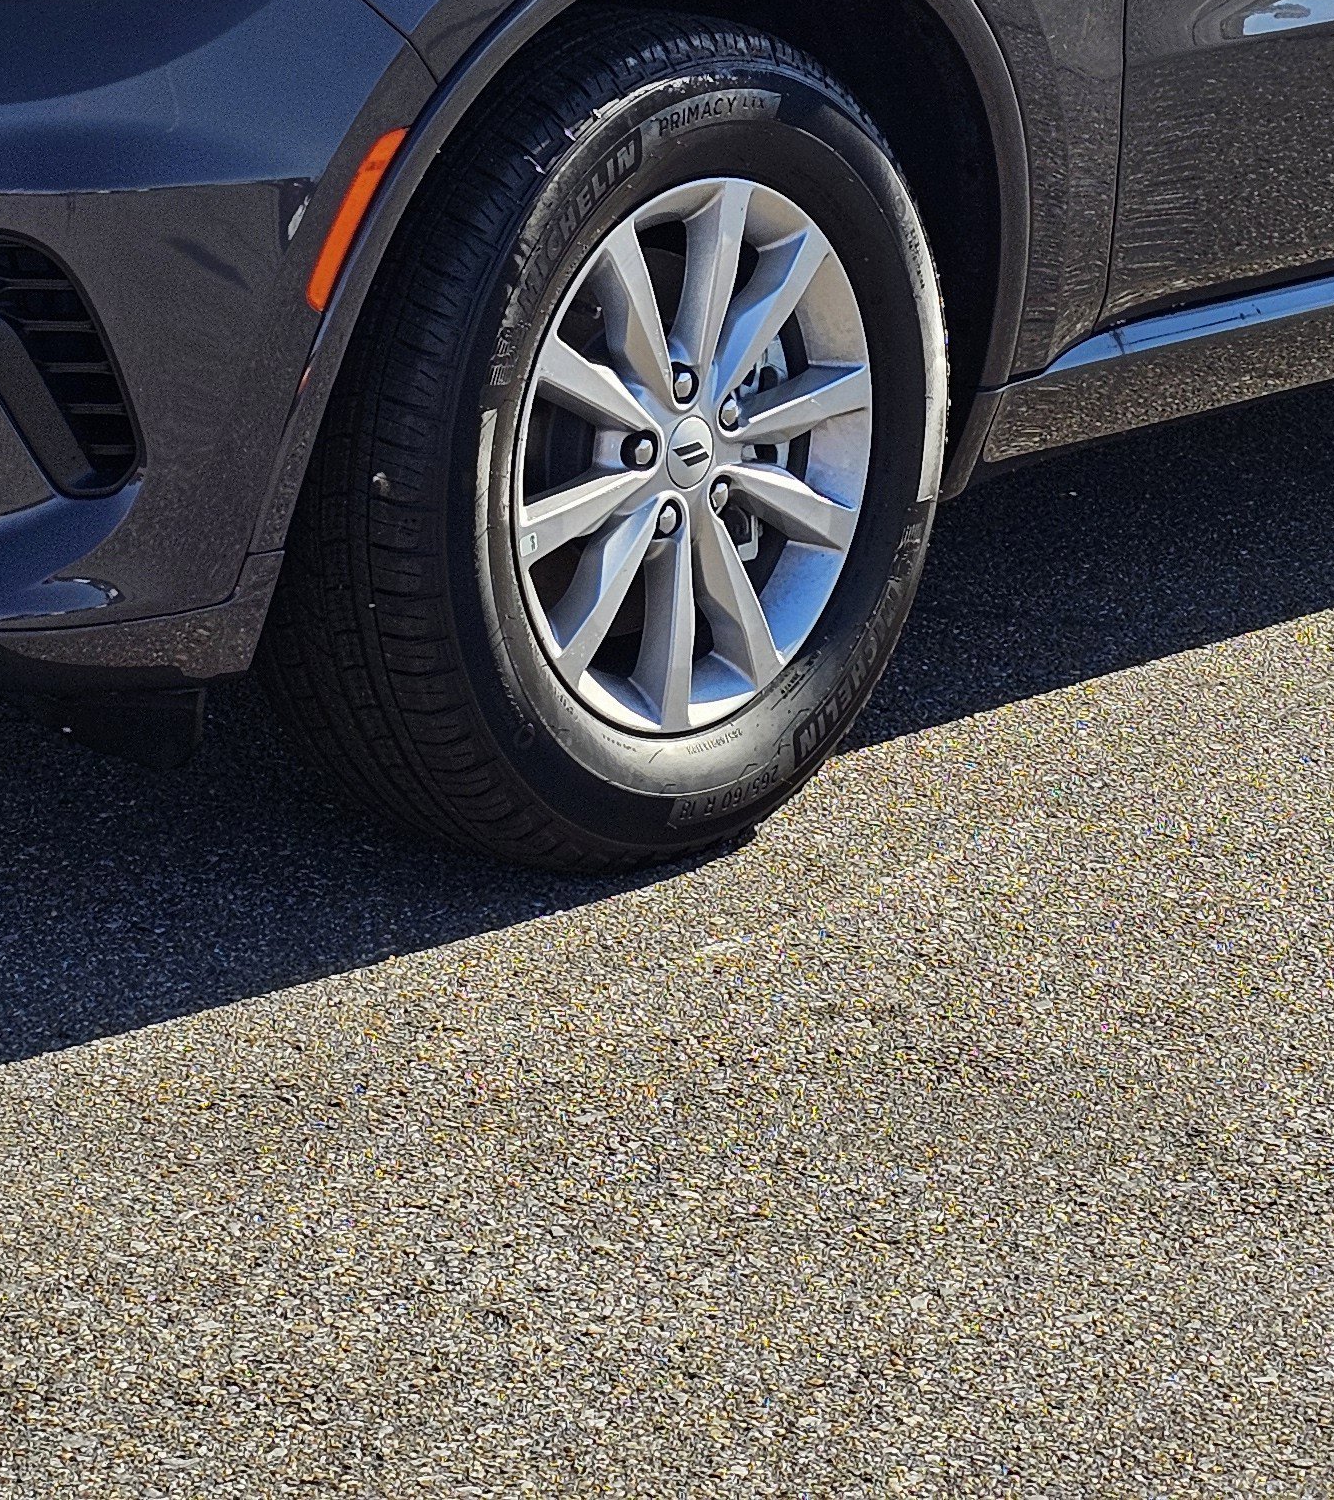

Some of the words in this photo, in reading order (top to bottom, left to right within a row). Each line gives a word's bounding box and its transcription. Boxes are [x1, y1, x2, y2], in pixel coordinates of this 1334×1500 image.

[656, 95, 738, 138] PRIMACY
[516, 140, 636, 321] MICHELIN
[798, 585, 901, 758] MICHELIN
